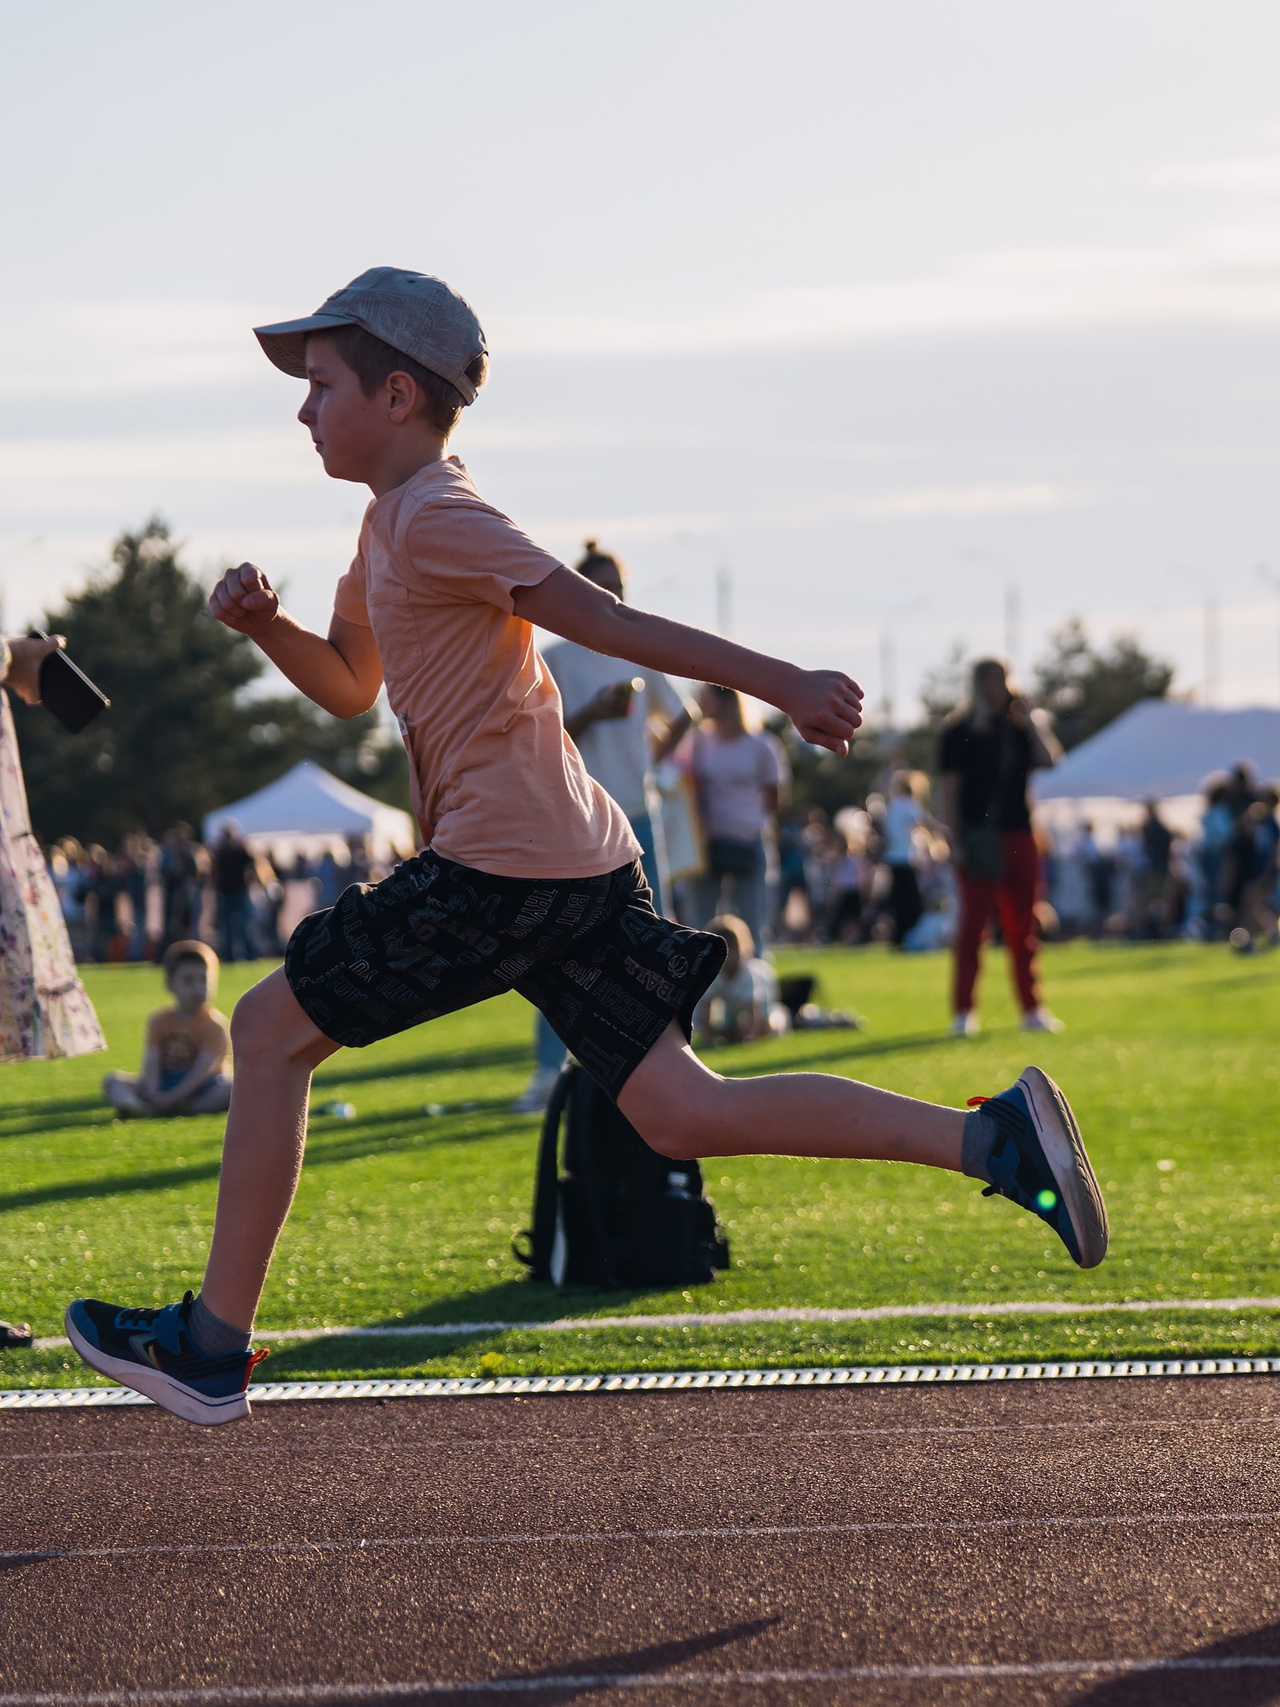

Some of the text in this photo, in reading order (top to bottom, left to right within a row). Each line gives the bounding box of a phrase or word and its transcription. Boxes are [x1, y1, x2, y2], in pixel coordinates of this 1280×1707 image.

[555, 893, 591, 926] BUT
[492, 952, 534, 985] NOT
[592, 976, 655, 1036] ACCEPT
